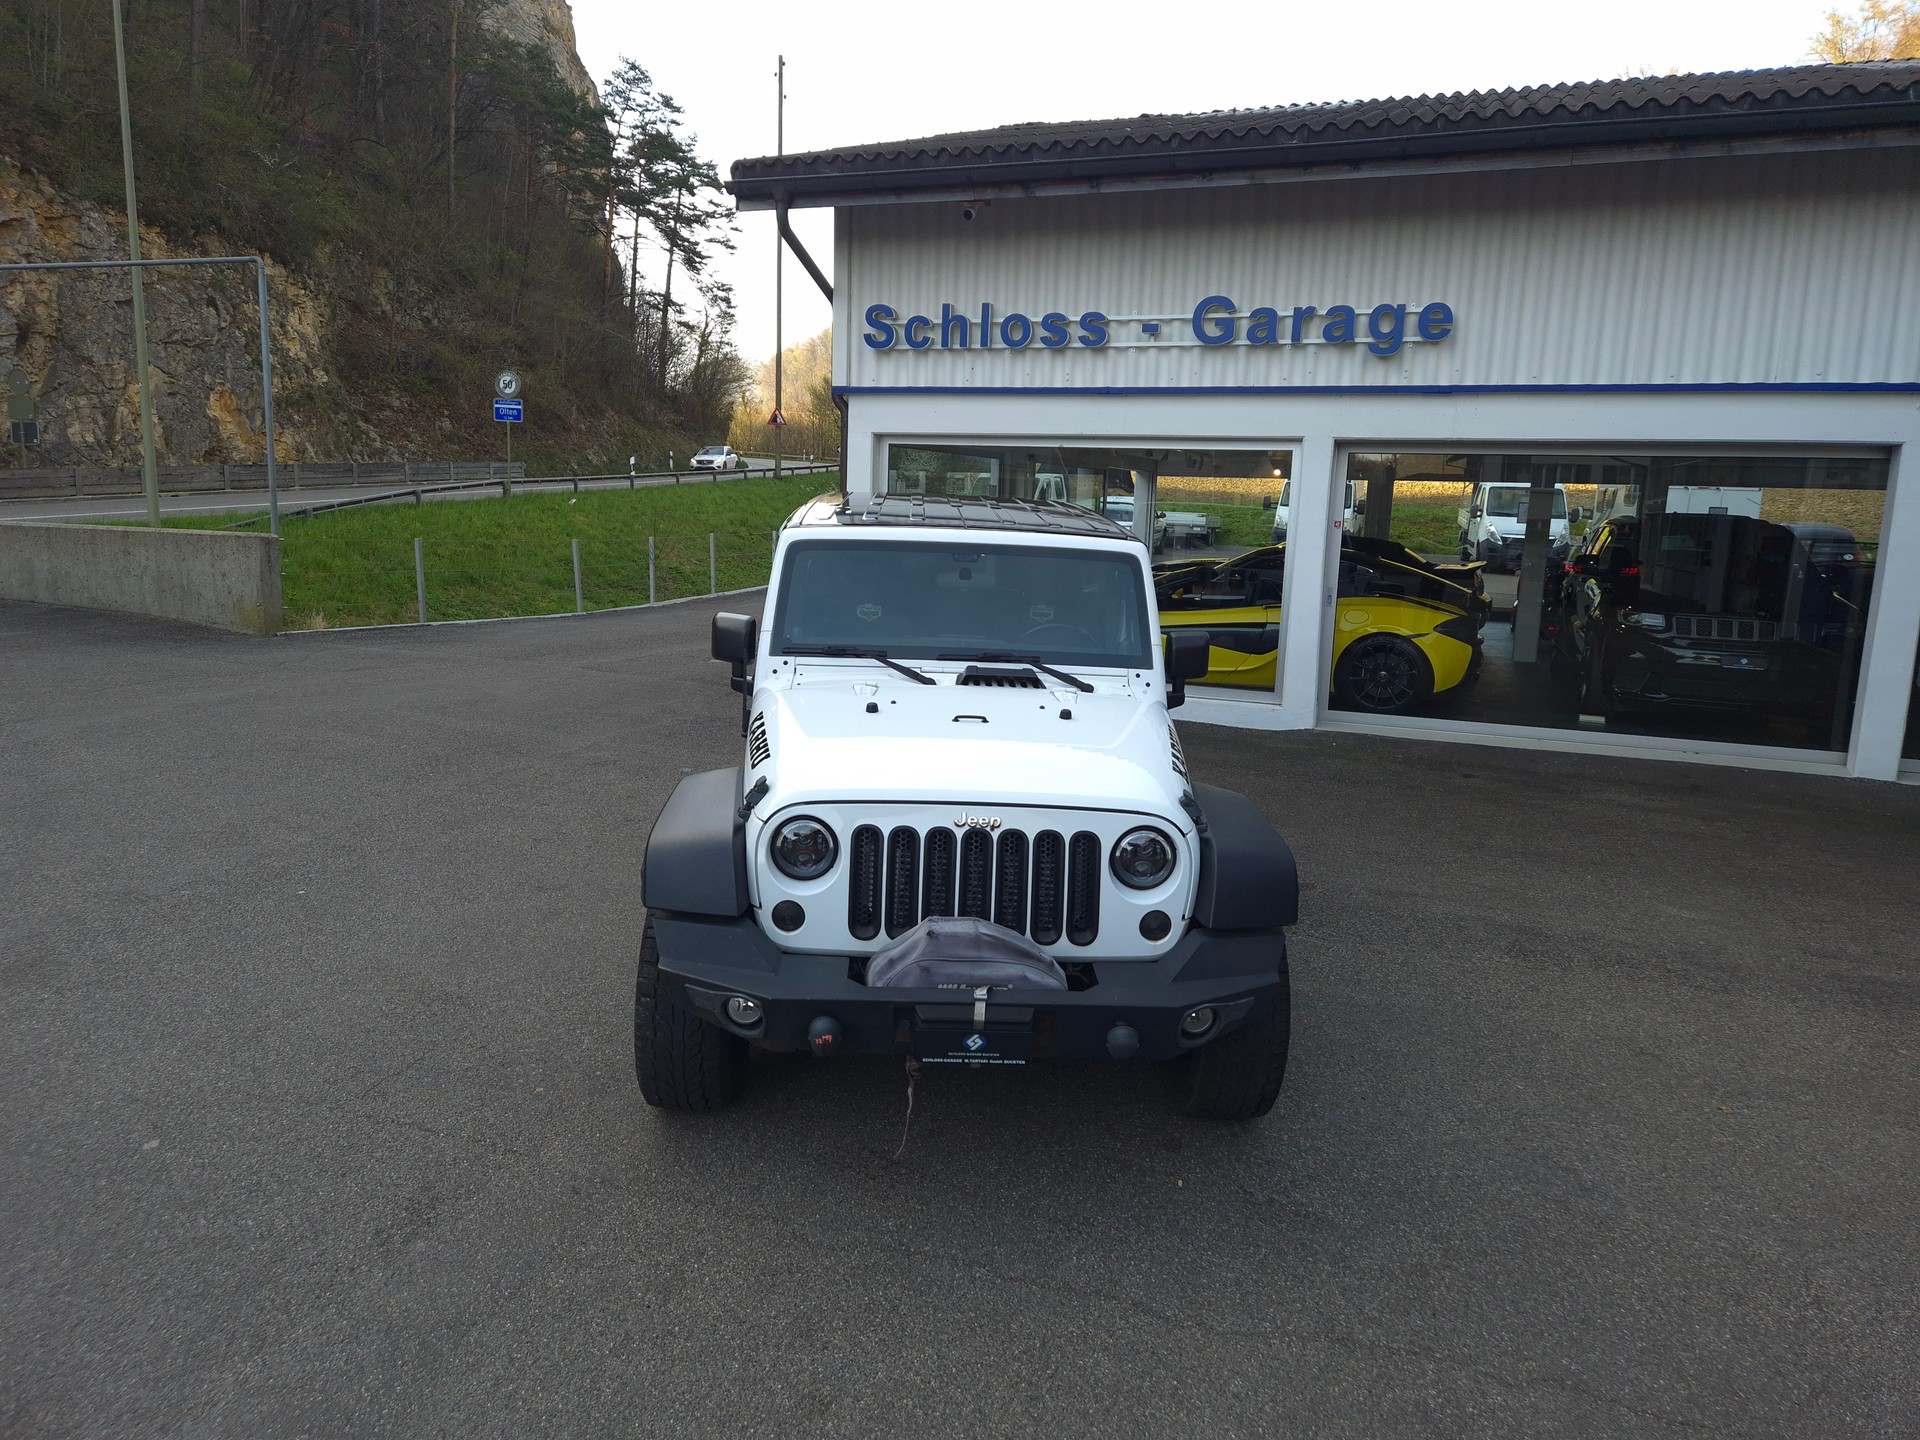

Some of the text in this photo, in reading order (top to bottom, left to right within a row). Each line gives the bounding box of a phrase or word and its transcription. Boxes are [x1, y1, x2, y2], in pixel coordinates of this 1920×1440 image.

[863, 302, 1109, 350] Schloss
[1192, 295, 1454, 356] Garage
[502, 379, 513, 390] 50
[499, 407, 517, 416] Olten
[954, 811, 1001, 831] Jeep
